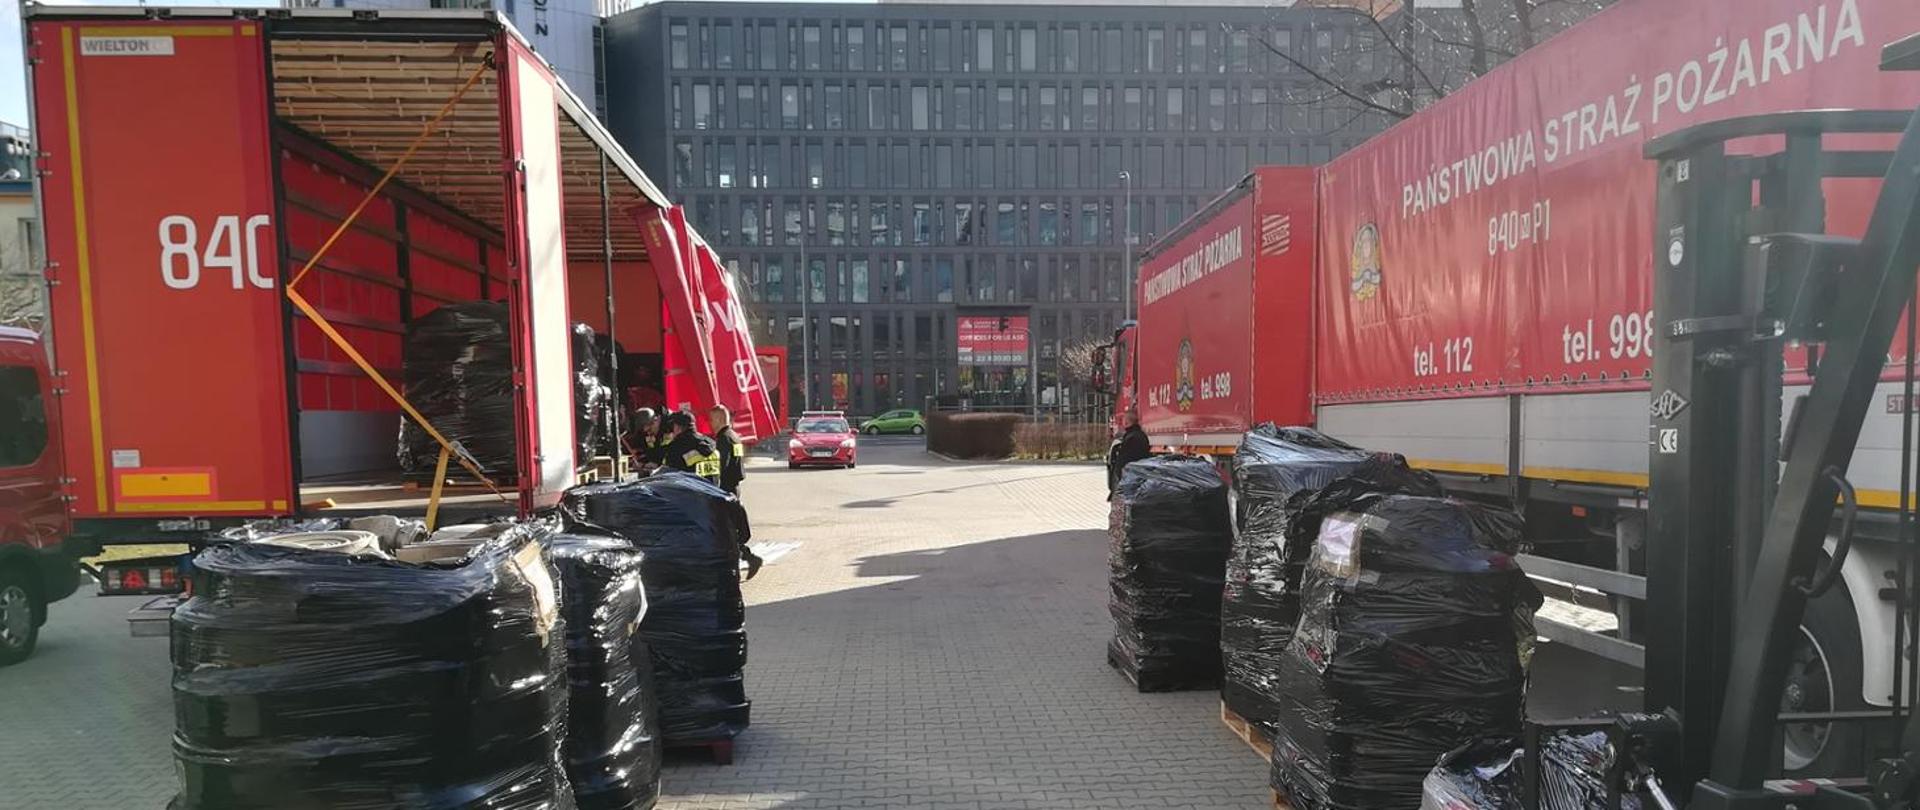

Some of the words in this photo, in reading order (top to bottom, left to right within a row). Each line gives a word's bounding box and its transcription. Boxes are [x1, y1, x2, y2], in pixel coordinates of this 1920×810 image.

[84, 39, 150, 52] WIELTON
[1403, 129, 1536, 219] PAŃSTWOWA
[1543, 75, 1642, 163] STRAŻ
[1652, 0, 1865, 124] POŻARNA
[1563, 318, 1600, 364] tel.
[1414, 341, 1438, 377] tel.
[1443, 336, 1473, 374] 112
[1160, 383, 1170, 405] 112
[1201, 374, 1214, 400] tel.
[1215, 371, 1231, 398] 998
[1661, 430, 1676, 451] CE
